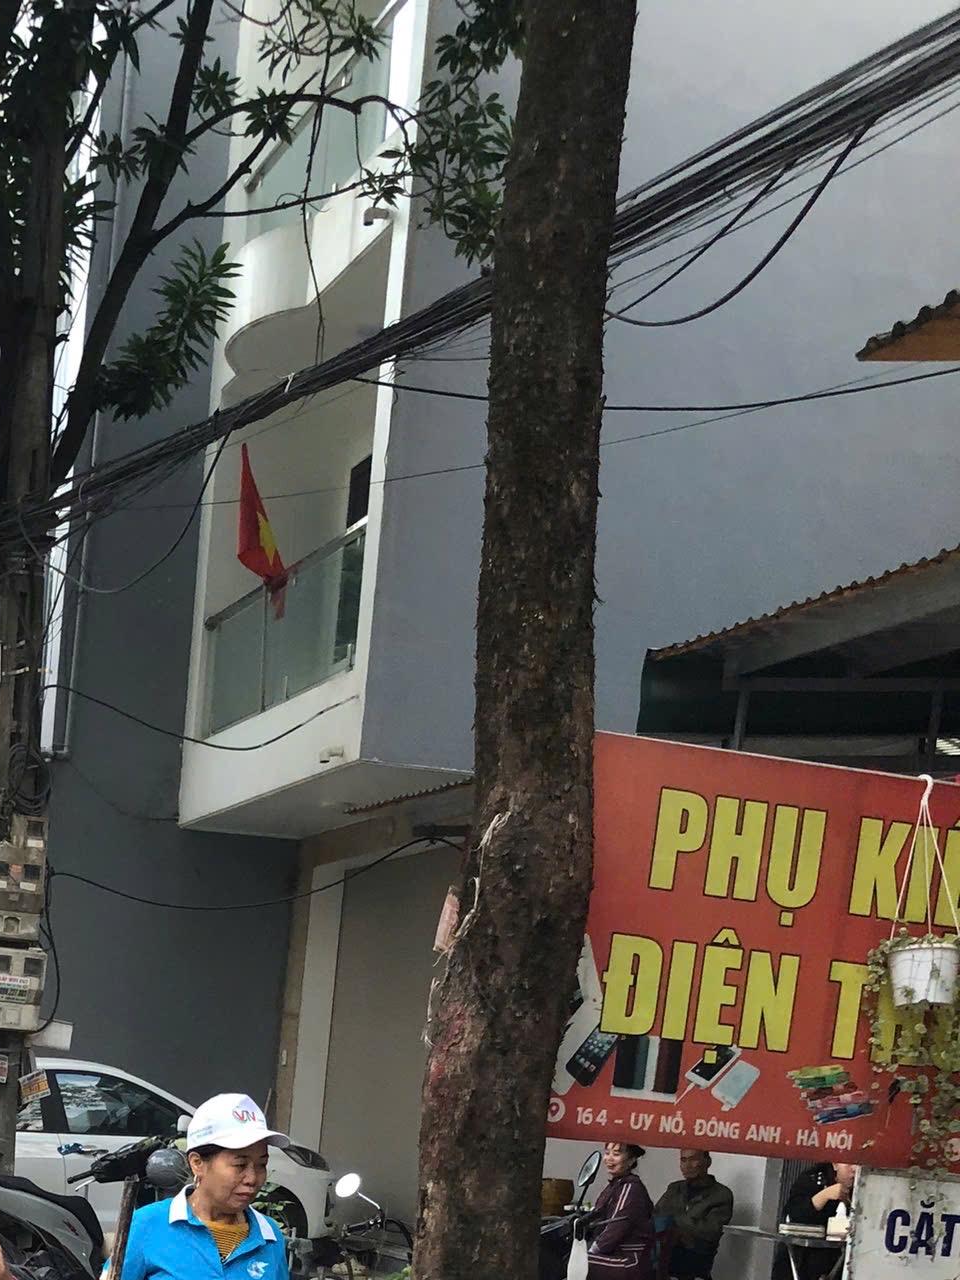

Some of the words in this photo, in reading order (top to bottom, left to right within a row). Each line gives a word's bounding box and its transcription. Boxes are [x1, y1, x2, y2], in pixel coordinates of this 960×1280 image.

[649, 786, 828, 927] PHỤ
[599, 928, 800, 1064] ĐIỆN
[576, 1107, 608, 1126] 164
[630, 1112, 654, 1131] UY
[693, 1116, 739, 1139] ĐÔNG
[745, 1124, 781, 1143] ANH
[796, 1127, 819, 1147] HÀ
[825, 1129, 853, 1152] NỘI
